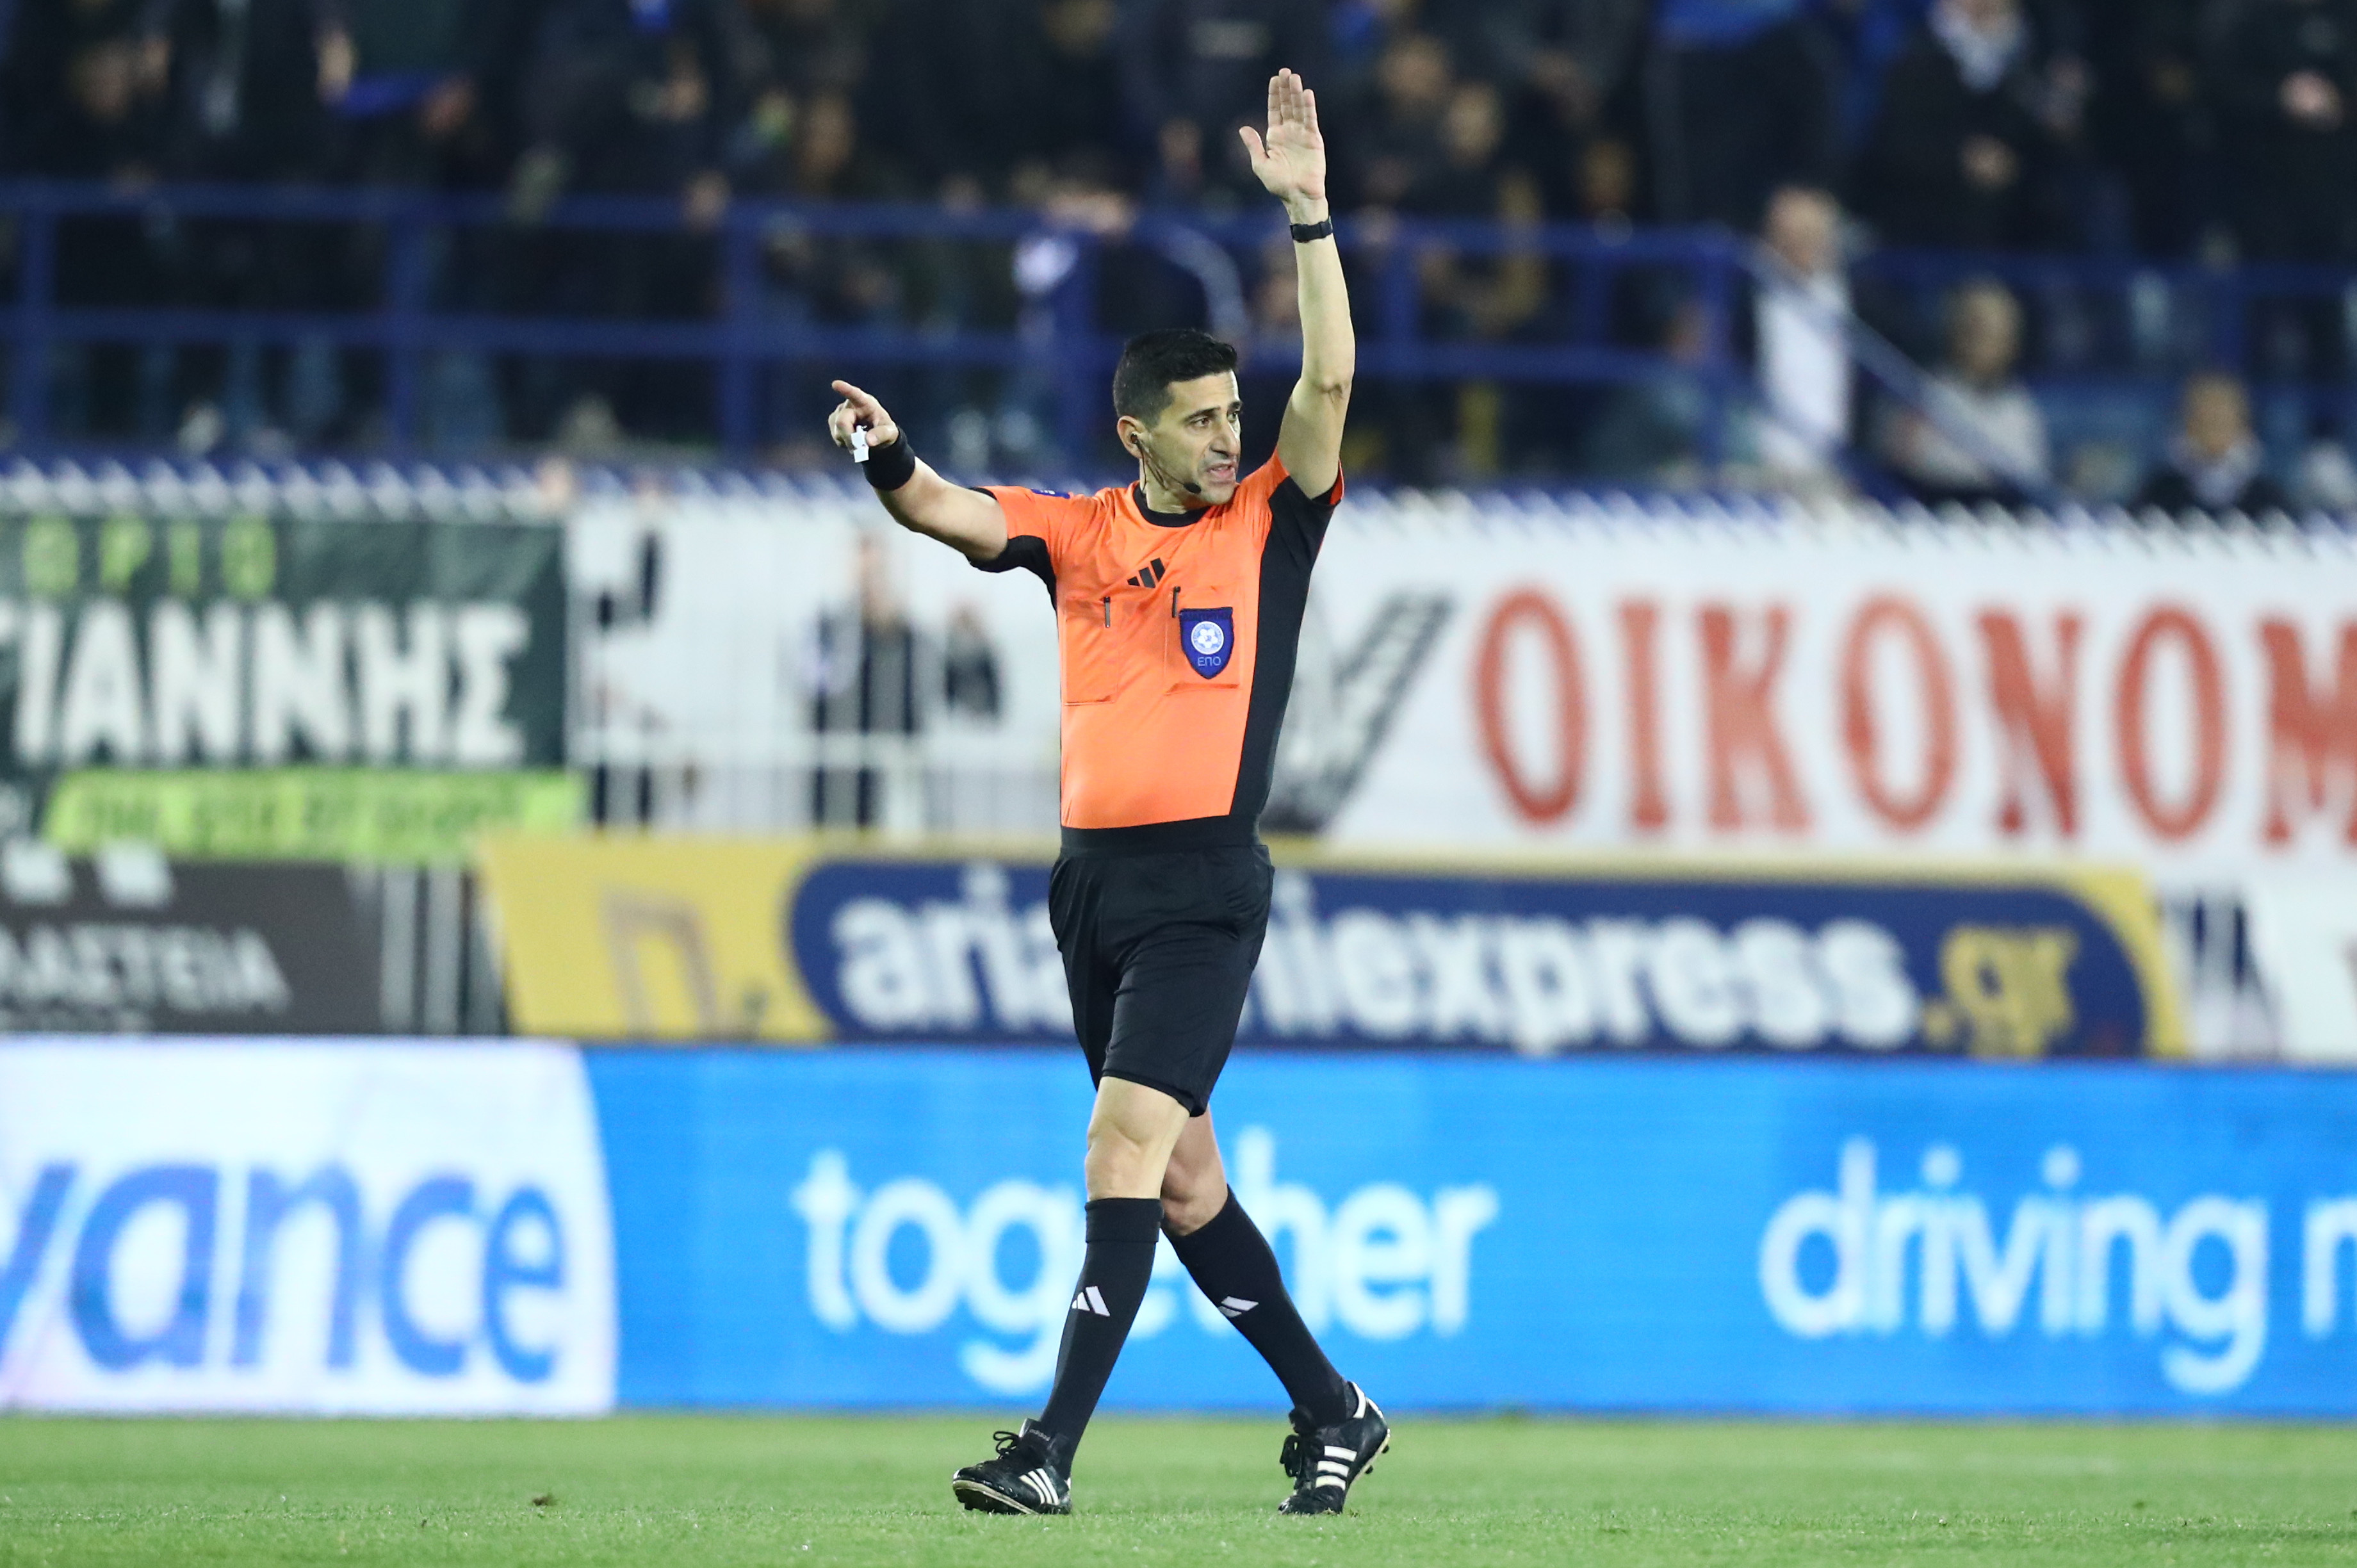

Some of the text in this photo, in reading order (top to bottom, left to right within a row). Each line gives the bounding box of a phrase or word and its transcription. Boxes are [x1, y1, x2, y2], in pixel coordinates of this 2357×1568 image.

[0, 599, 530, 765] ΙΑΝΝΗΣ
[1197, 656, 1222, 667] ΕΠΟ
[790, 1126, 1500, 1396] togher
[1759, 1135, 2269, 1395] driving
